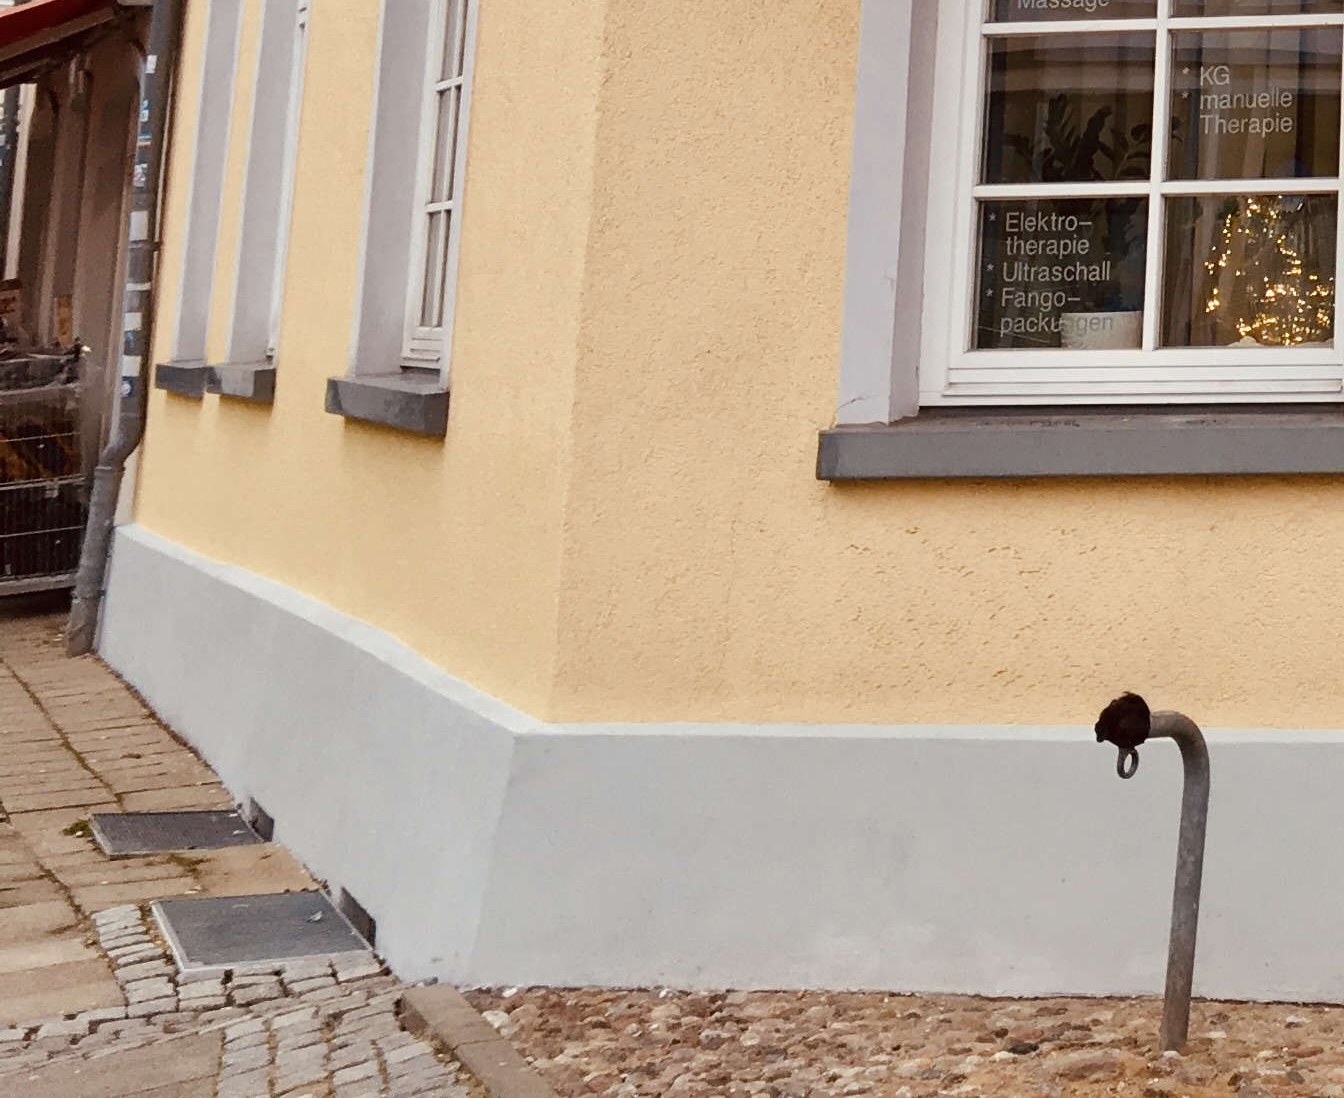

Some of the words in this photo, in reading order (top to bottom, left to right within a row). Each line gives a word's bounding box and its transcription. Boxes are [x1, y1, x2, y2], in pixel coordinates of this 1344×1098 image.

[1199, 65, 1230, 87] KG
[1199, 87, 1293, 110] manuelle
[1199, 112, 1293, 138] Therapie
[1005, 211, 1093, 233] Elektro-
[1006, 233, 1090, 259] therapie
[1002, 260, 1111, 282] Ultraschall
[1001, 287, 1081, 312] Fango-
